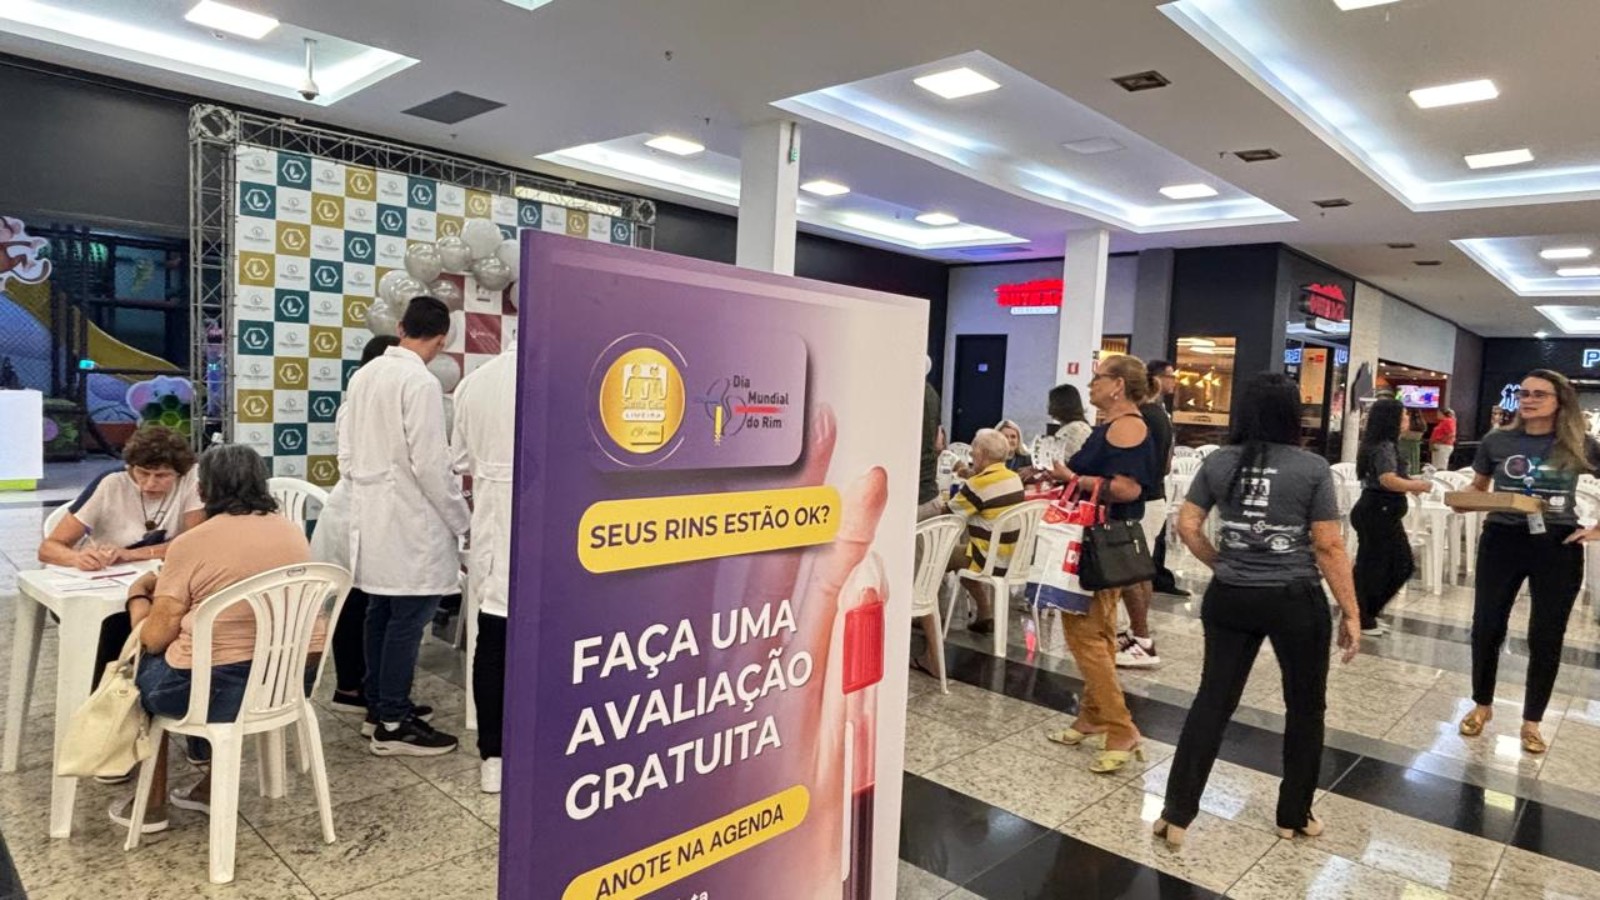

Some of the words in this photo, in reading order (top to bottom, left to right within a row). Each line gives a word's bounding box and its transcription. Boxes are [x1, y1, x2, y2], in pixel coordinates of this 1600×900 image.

[733, 374, 751, 389] Dia
[747, 390, 789, 406] Mundial
[746, 416, 759, 429] do
[762, 416, 782, 429] Rim
[590, 521, 657, 550] SEUS
[664, 515, 718, 542] RINS
[724, 505, 789, 534] ESTÃO
[794, 505, 831, 527] OK?
[571, 618, 700, 685] FAÇA
[711, 599, 798, 650] UMA
[565, 648, 814, 756] AVALIAÇÃO
[565, 715, 782, 822] GRATUITA
[595, 851, 671, 900] ANOTE
[677, 838, 705, 866] NA
[710, 804, 784, 852] AGENDA
